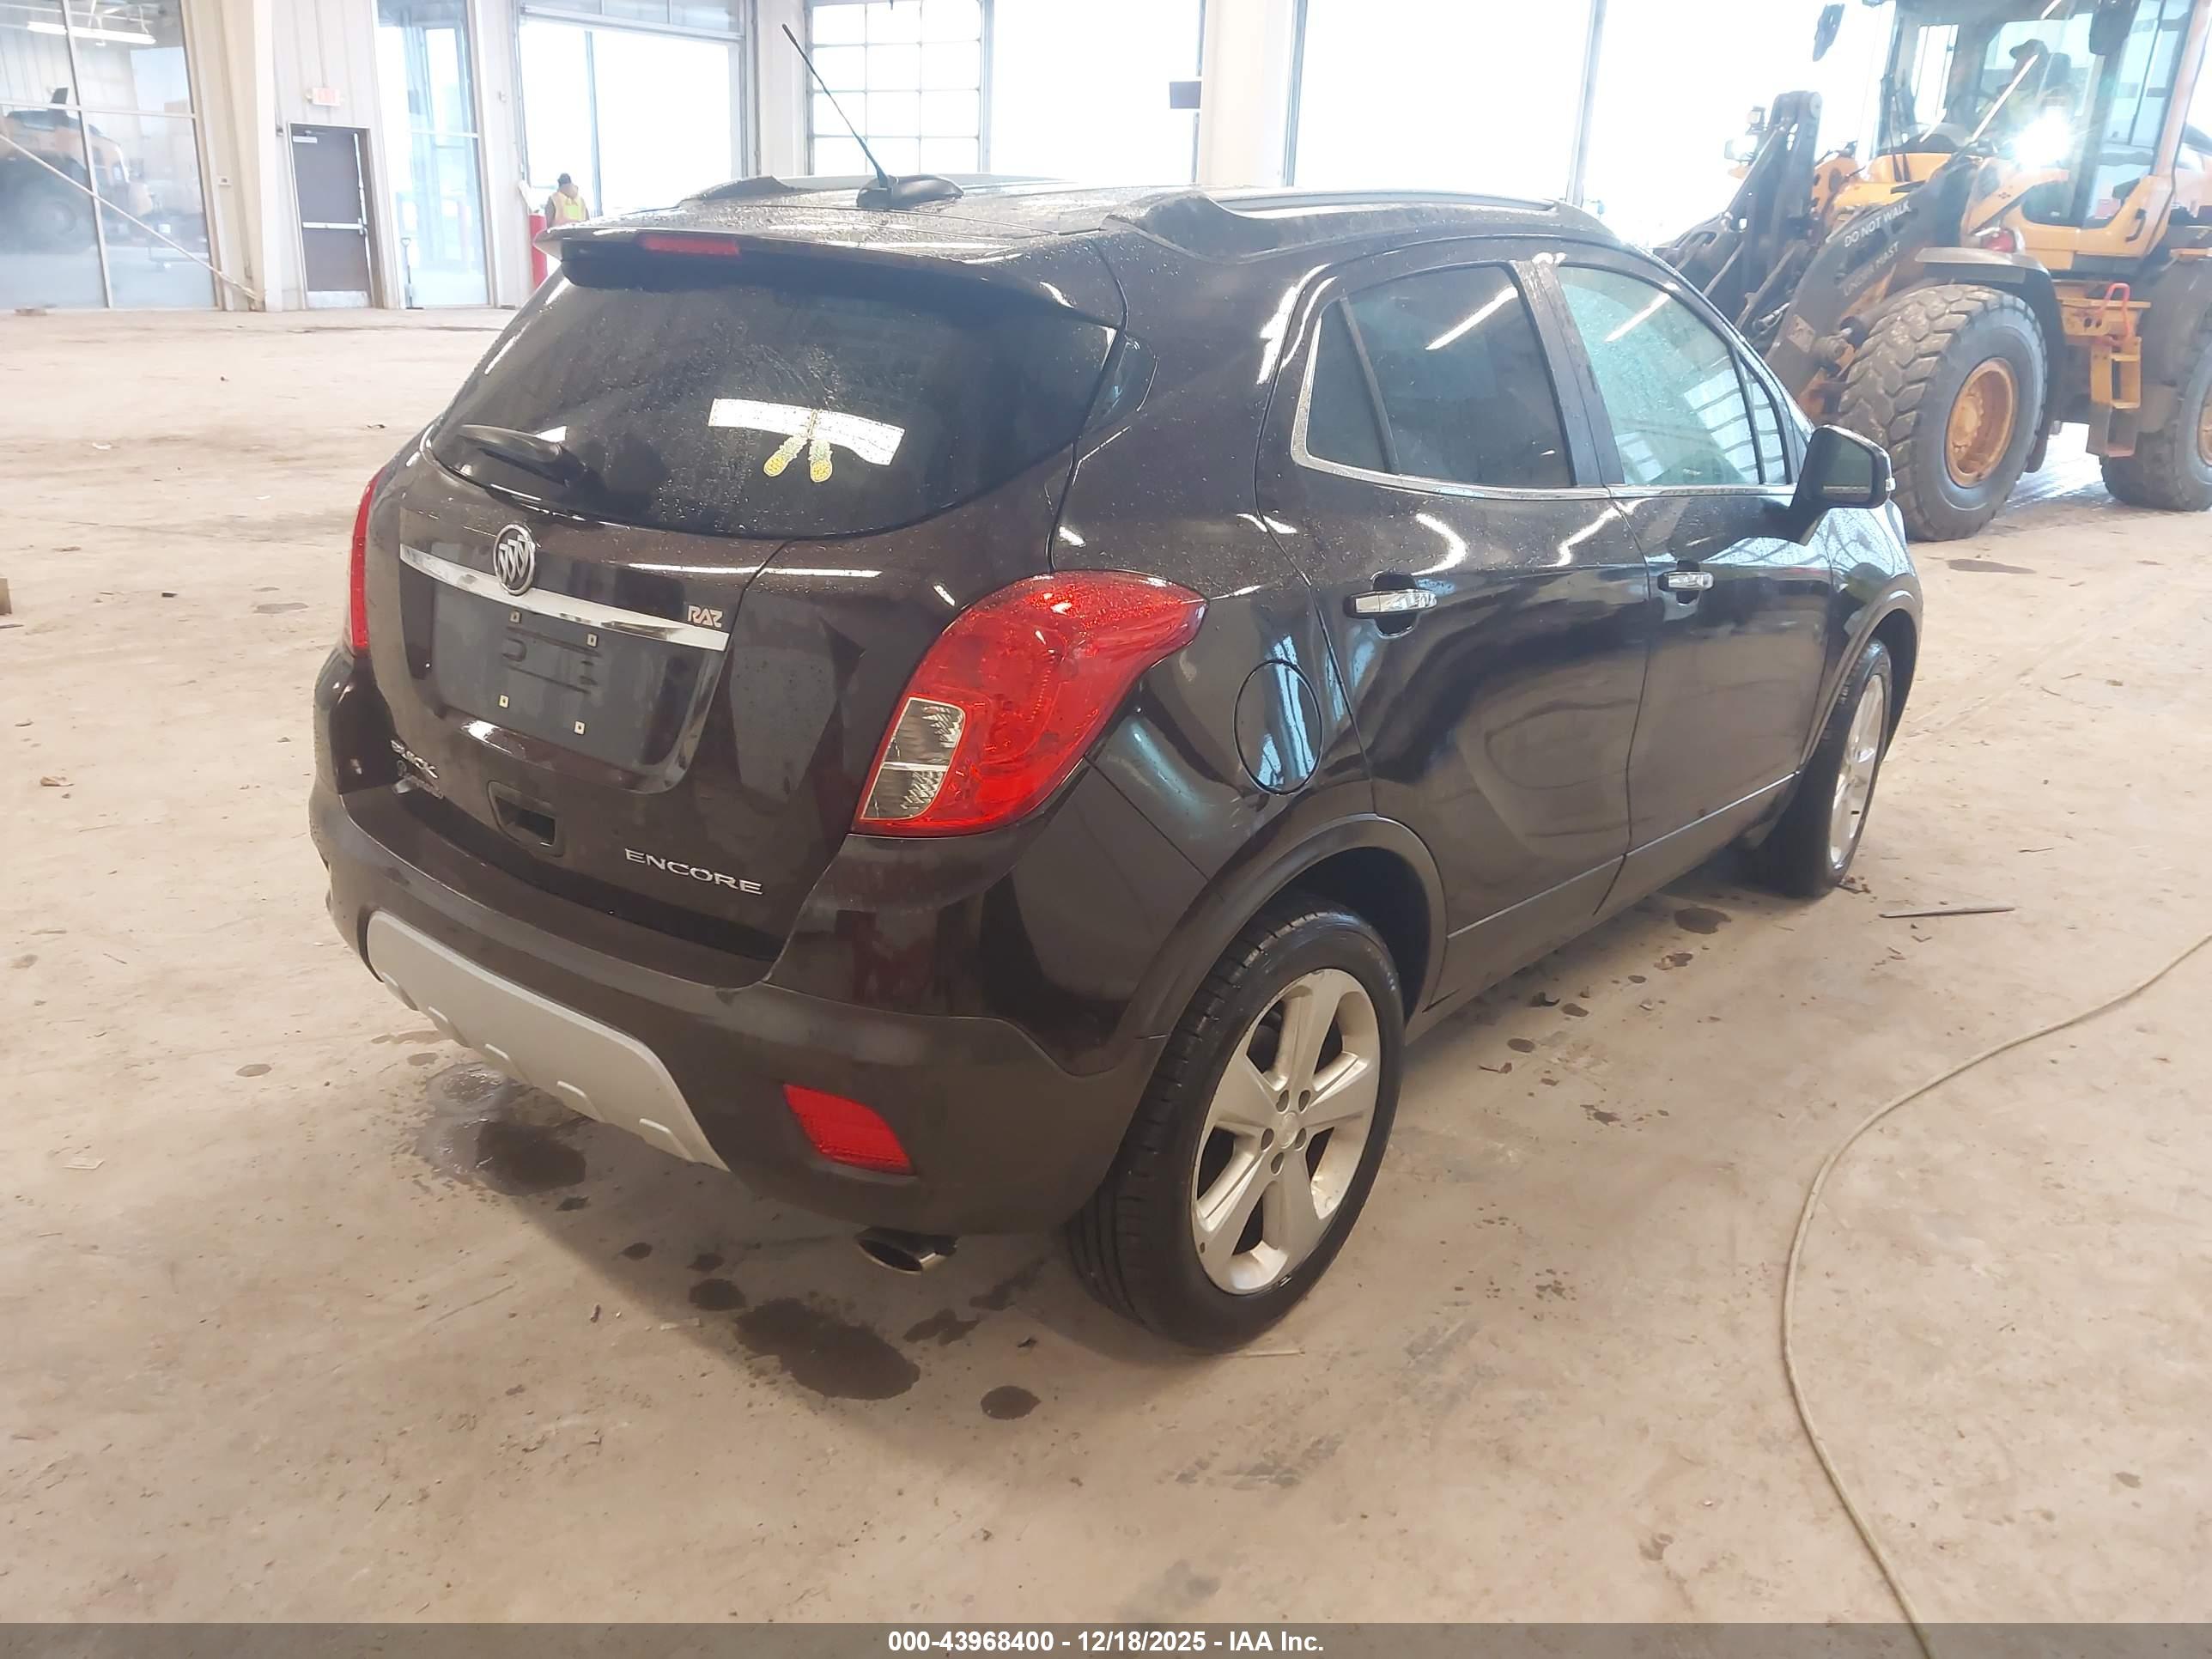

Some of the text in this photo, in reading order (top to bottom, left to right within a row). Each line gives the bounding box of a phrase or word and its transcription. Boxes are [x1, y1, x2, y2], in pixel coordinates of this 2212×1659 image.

[1844, 200, 1912, 247] DO NOT WALK
[1875, 240, 1899, 268] MAST
[624, 848, 763, 895] ENCORE
